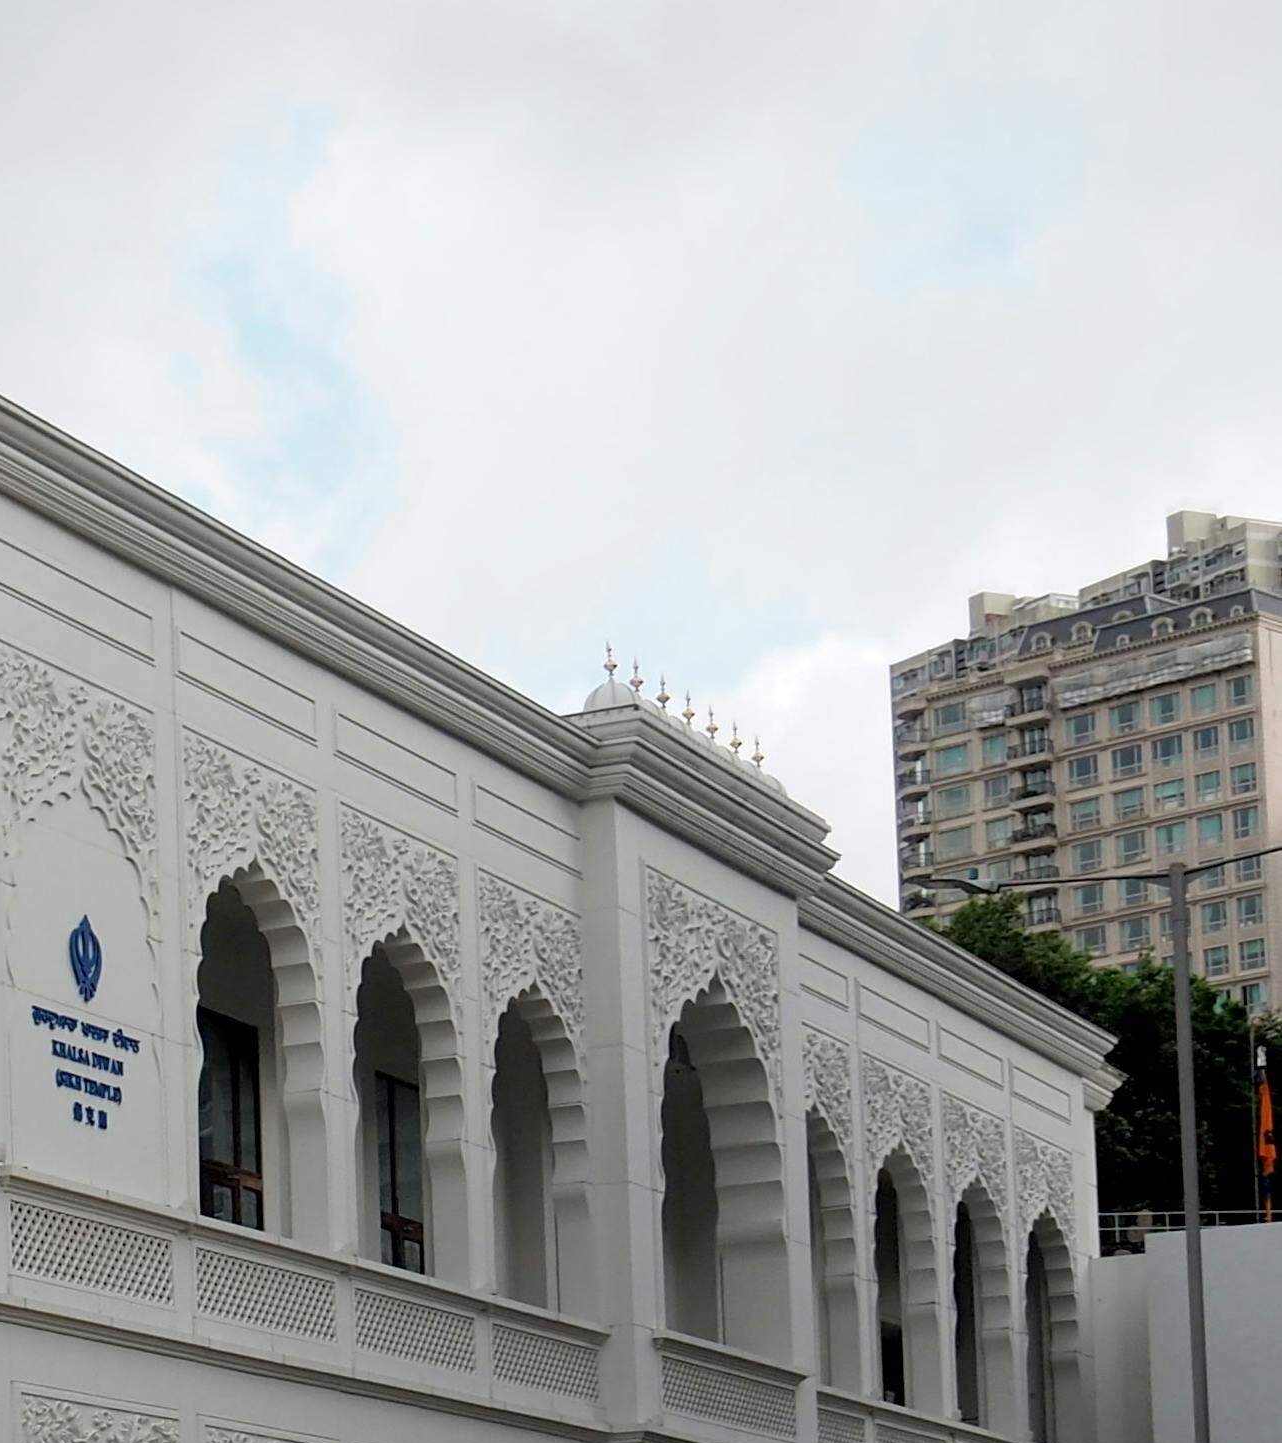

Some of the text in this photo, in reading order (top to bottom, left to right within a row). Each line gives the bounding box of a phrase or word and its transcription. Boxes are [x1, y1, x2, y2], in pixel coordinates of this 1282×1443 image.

[51, 1039, 124, 1077] KHALSA DIWAN
[56, 1068, 122, 1106] (SIKH TEMPLE)
